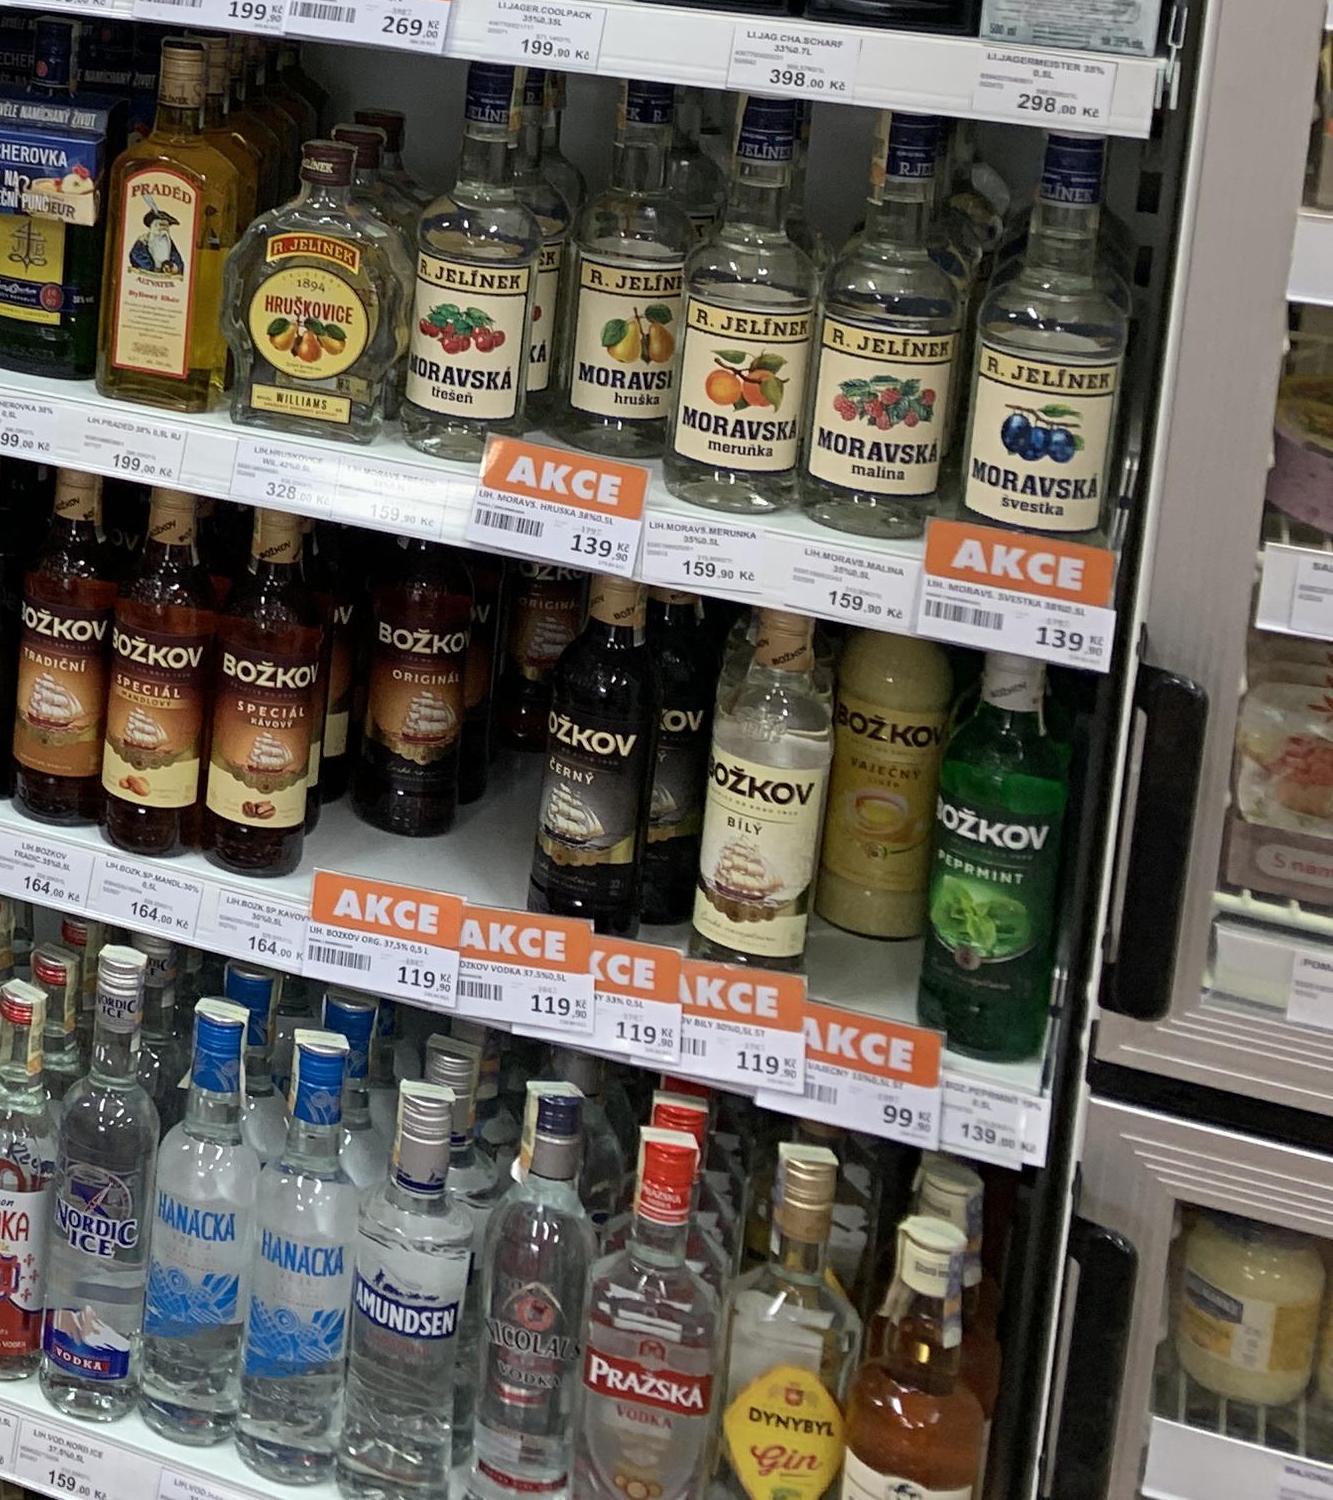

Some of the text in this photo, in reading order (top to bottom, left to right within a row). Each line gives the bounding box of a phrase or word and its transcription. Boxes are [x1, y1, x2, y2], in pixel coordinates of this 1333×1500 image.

[130, 181, 192, 205] PRADĚD
[273, 239, 355, 265] R. JELÍNEK
[419, 258, 521, 290] R. JELÍNEK
[264, 293, 353, 325] HRUŠKOVICE
[696, 309, 808, 337] R. JELÍNEK
[832, 328, 949, 358] R. JELÍNEK
[987, 359, 1111, 390] R. JELÍNEK
[276, 394, 328, 410] WILLIAMS
[431, 385, 473, 405] třešeň
[613, 392, 660, 407] hruška
[708, 438, 774, 459] meruňka
[505, 456, 621, 505] AKCE
[851, 462, 905, 482] malina
[971, 457, 1098, 499] MORAVSKÁ
[1001, 495, 1064, 516] švestka
[952, 539, 1085, 589] AKCE
[23, 648, 86, 673] TRADIČNÍ
[113, 628, 204, 669] BOŽKOV
[223, 651, 319, 689] BOŽKOV
[116, 673, 181, 699] SPECIÁL
[236, 699, 305, 718] SPECIÁL
[549, 756, 594, 785] ČERNÝ
[727, 815, 763, 836] BÍLÝ
[937, 849, 1024, 885] PEPRMINT
[333, 888, 438, 934] AKCE
[461, 918, 565, 959] AKCE
[802, 1023, 914, 1073] AKCE
[53, 1202, 138, 1246] NORDIC
[67, 1230, 117, 1259] ICE
[355, 1287, 457, 1337] AMUNDSEN
[55, 1347, 104, 1373] VODKA
[496, 1360, 560, 1390] VODKA
[589, 1357, 705, 1410] PRAŽSKÁ
[616, 1405, 673, 1428] VODKA
[750, 1442, 823, 1474] Gin
